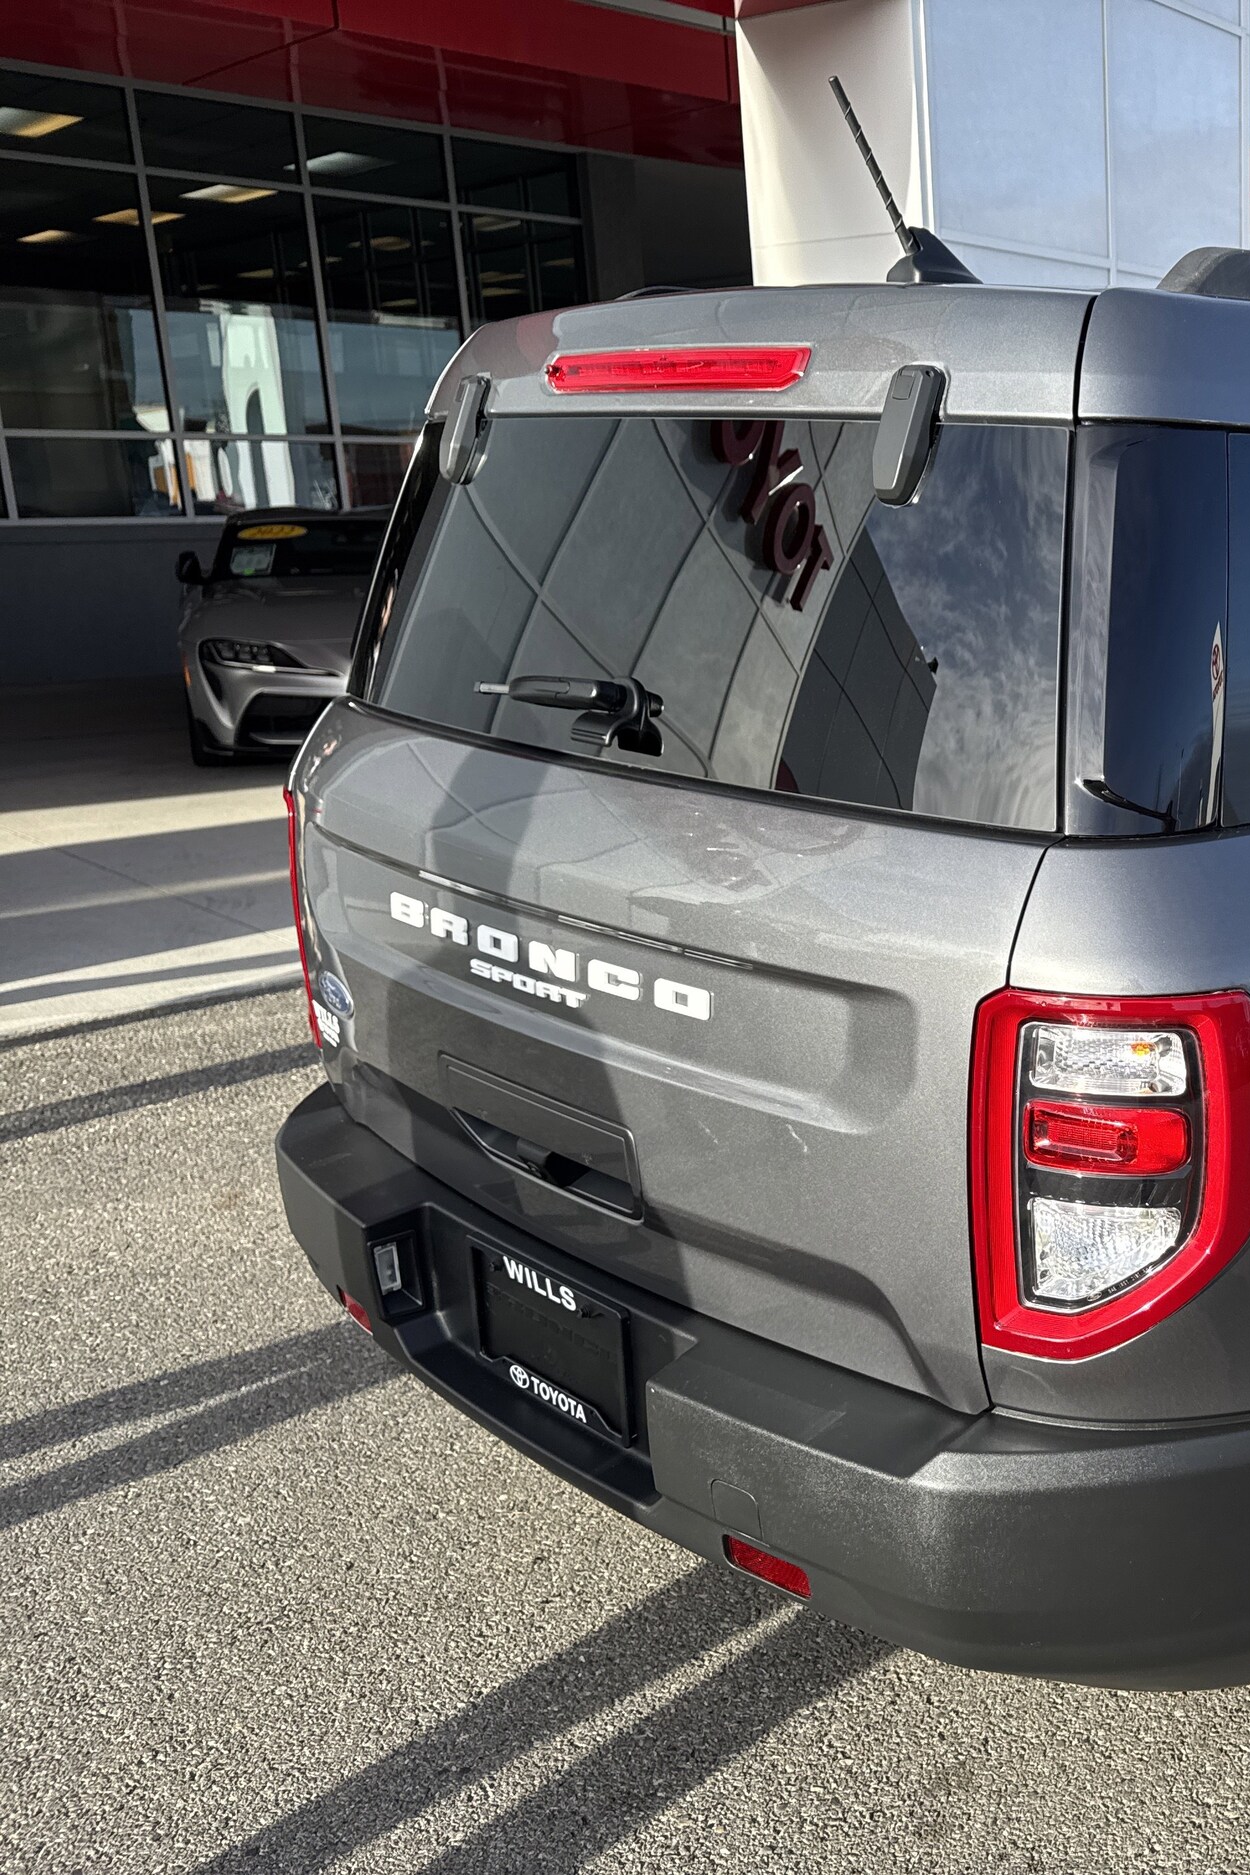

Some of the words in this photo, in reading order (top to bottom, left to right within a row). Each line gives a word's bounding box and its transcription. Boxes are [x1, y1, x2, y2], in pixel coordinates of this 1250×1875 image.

[389, 891, 713, 1021] BRONCO
[470, 957, 588, 1009] SPORT
[502, 1255, 577, 1312] WILLS
[530, 1376, 588, 1424] TOYOTA
